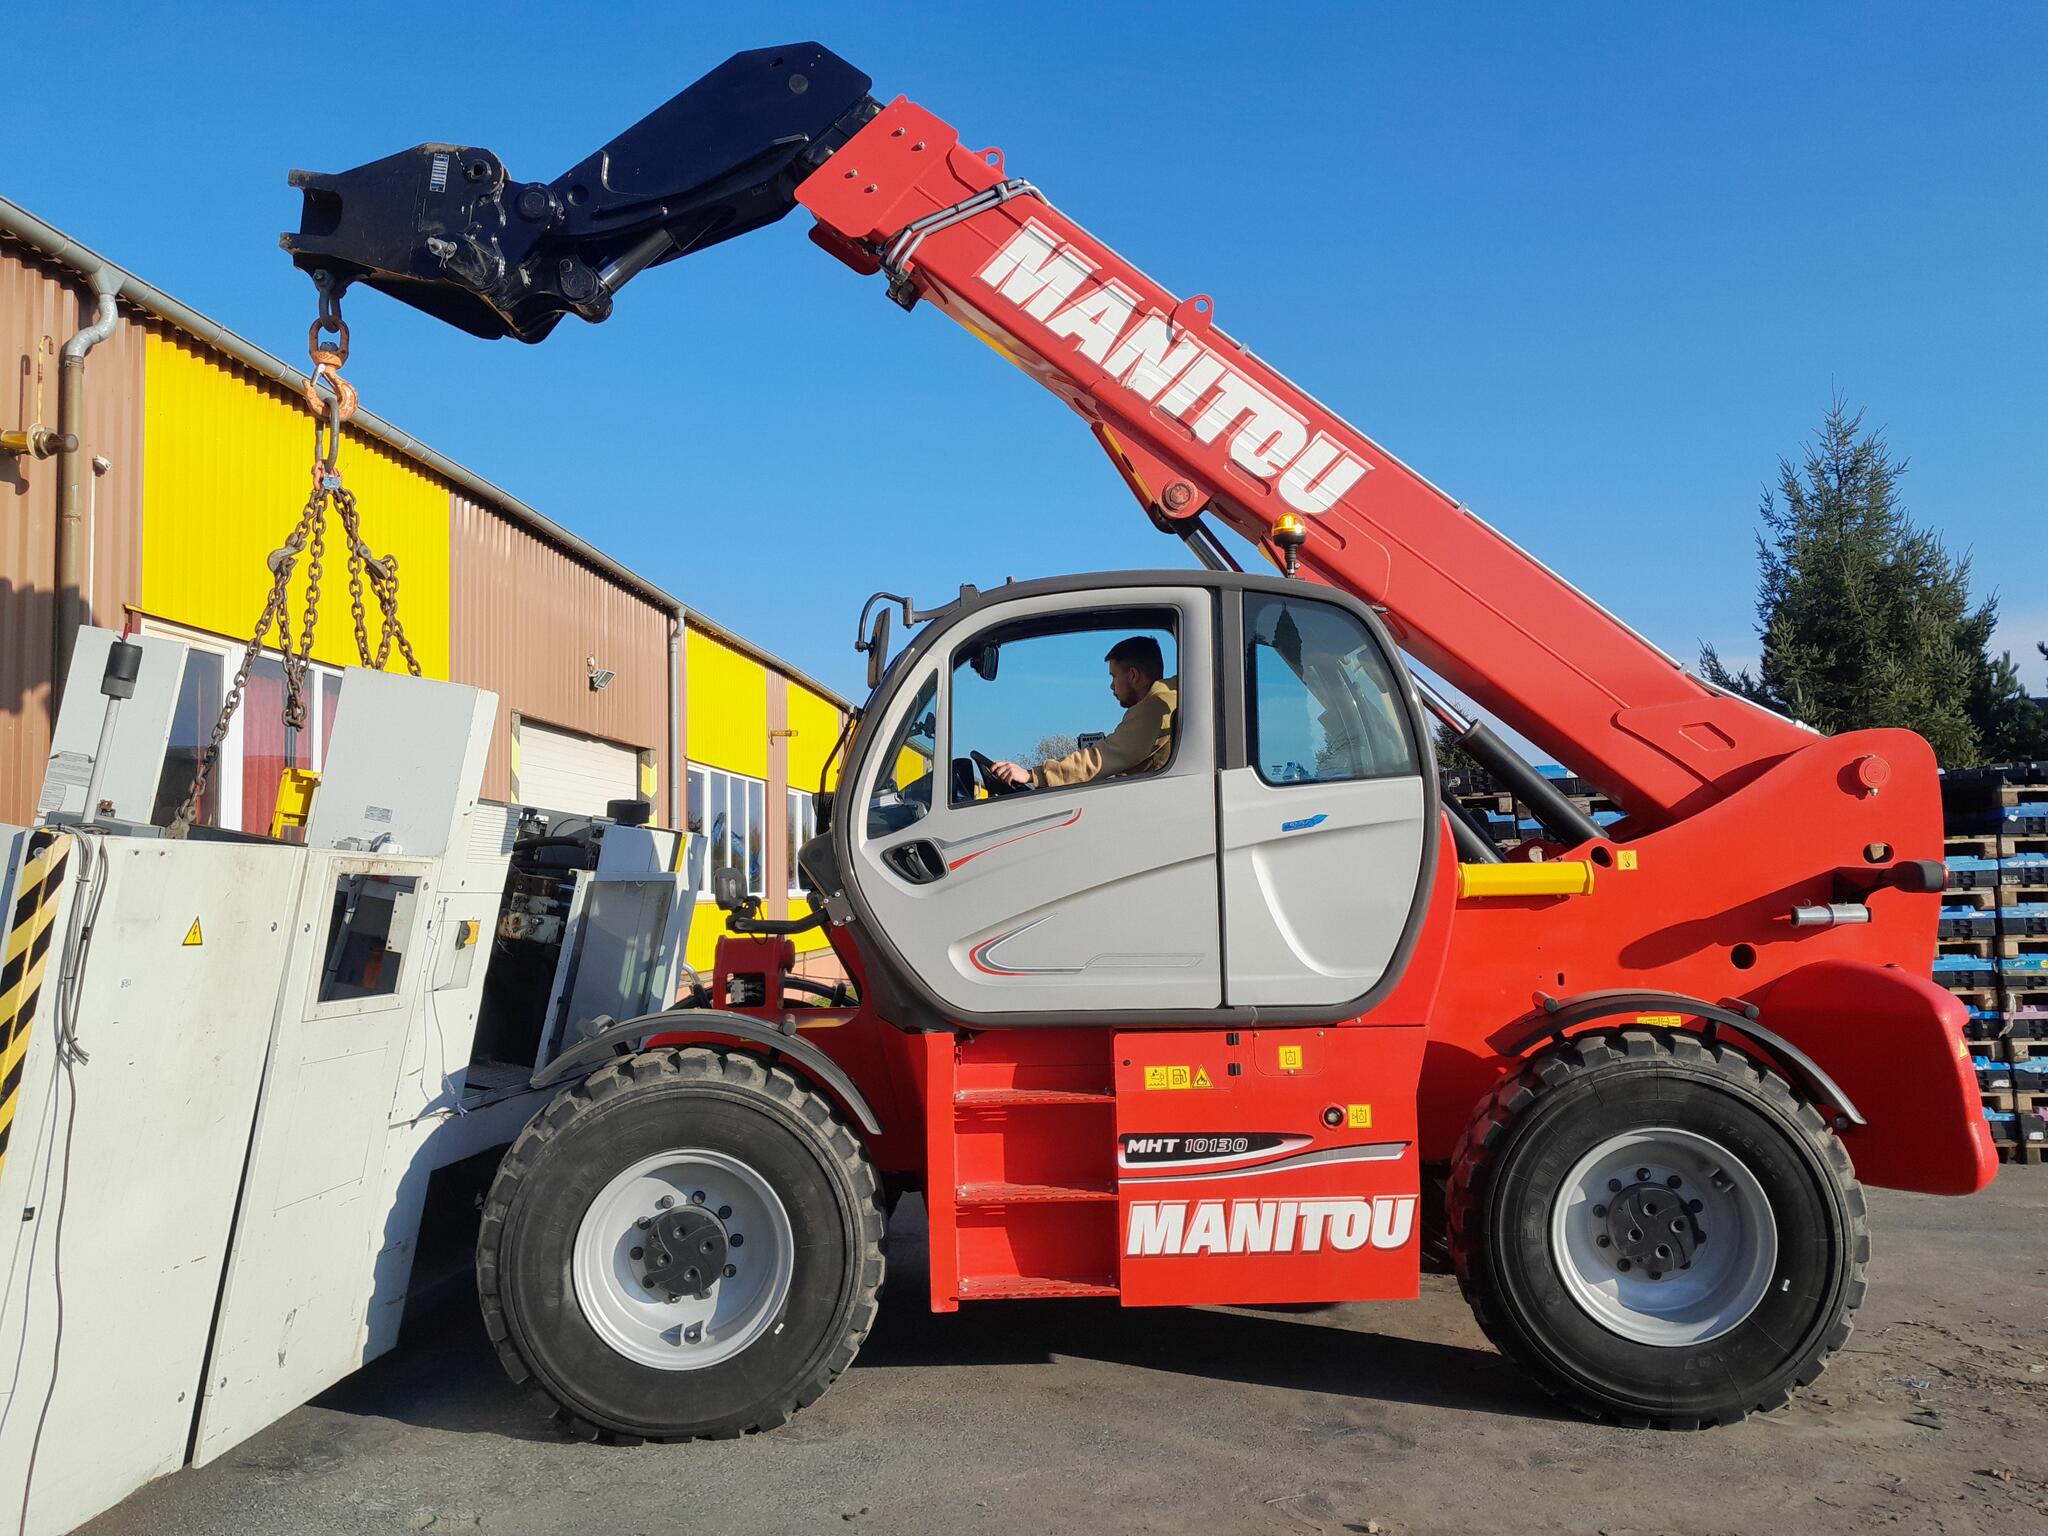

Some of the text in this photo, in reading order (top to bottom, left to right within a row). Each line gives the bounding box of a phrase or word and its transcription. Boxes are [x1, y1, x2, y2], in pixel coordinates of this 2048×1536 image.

[975, 218, 1372, 514] MANITOU
[1127, 1137, 1249, 1153] MHT 10130
[1126, 1196, 1418, 1257] MANITOU
